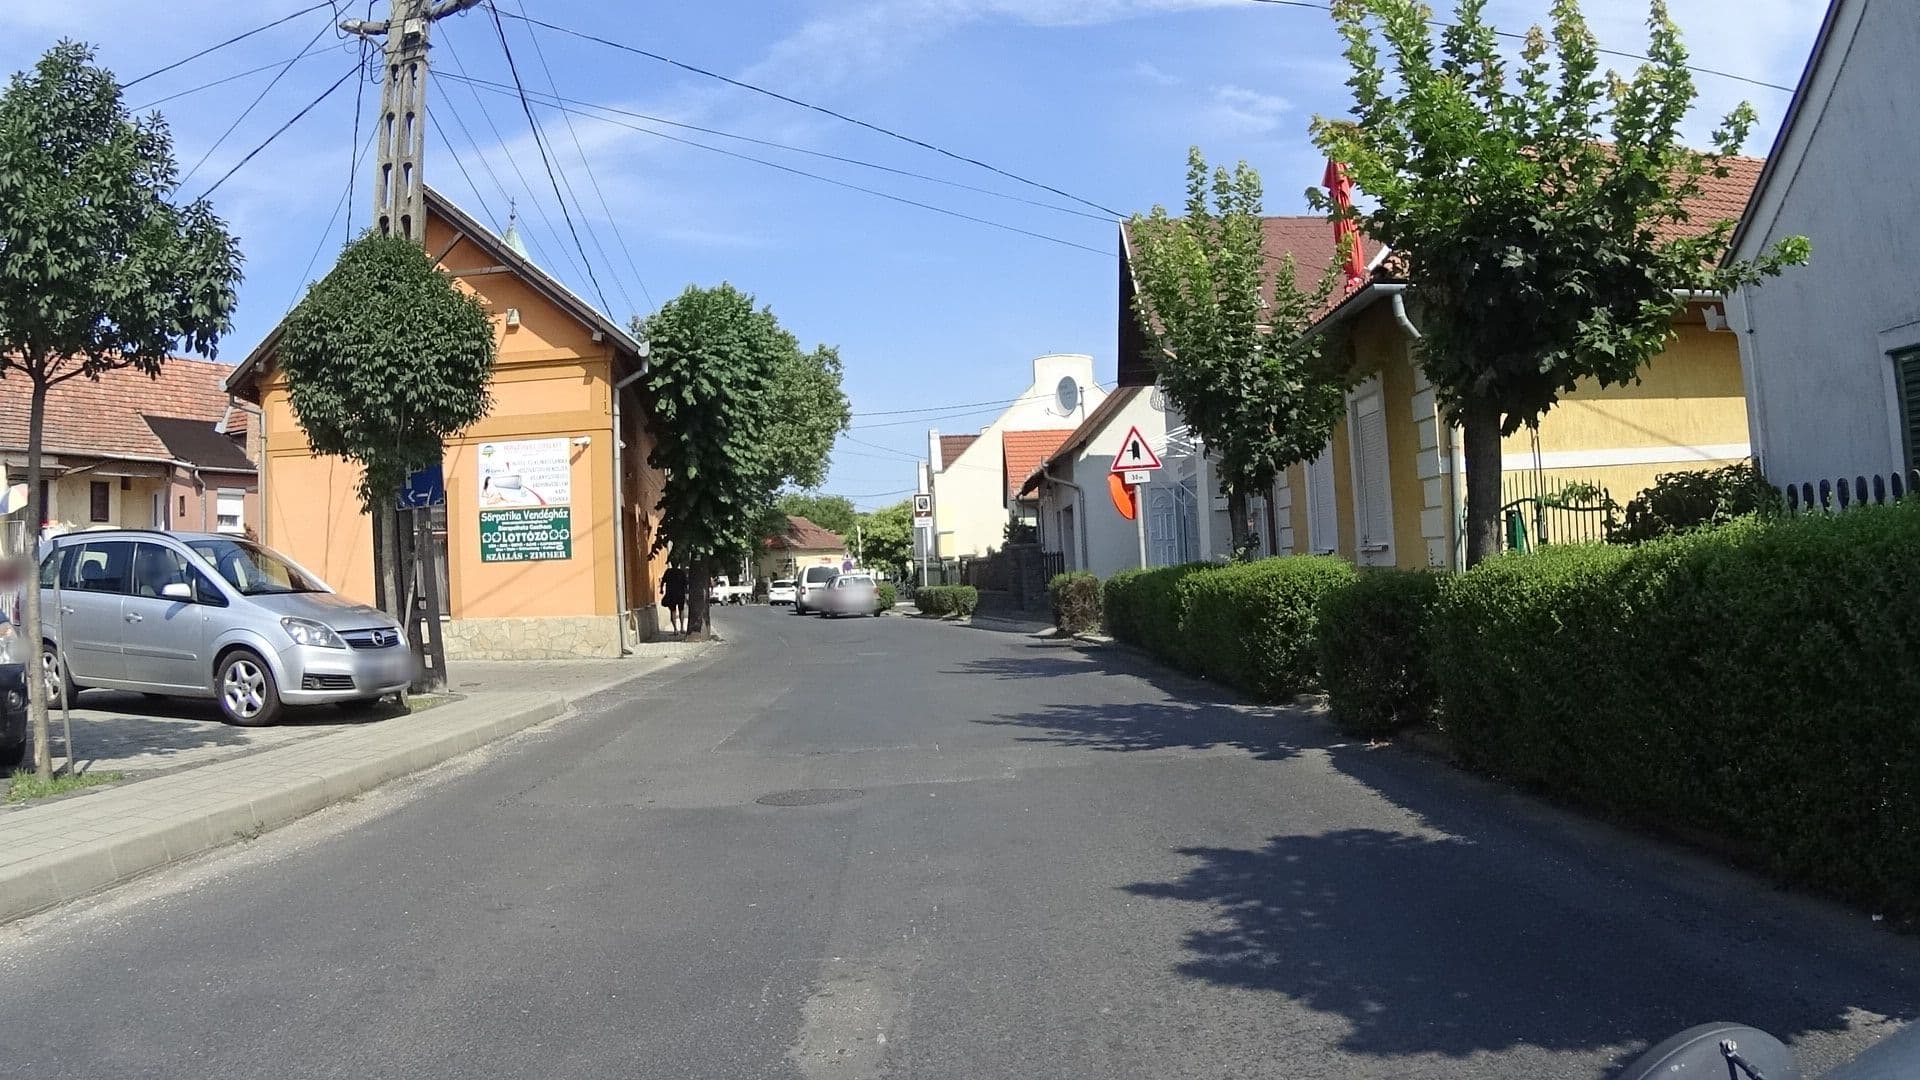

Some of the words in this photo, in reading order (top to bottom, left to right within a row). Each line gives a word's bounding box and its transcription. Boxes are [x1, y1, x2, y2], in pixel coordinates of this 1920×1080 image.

[481, 511, 521, 524] Sörpatika
[523, 509, 568, 521] Vendégház
[502, 530, 548, 543] LOTTÓZÓ
[486, 552, 523, 561] SZÁLLÁS
[530, 551, 566, 560] ZIMMER
